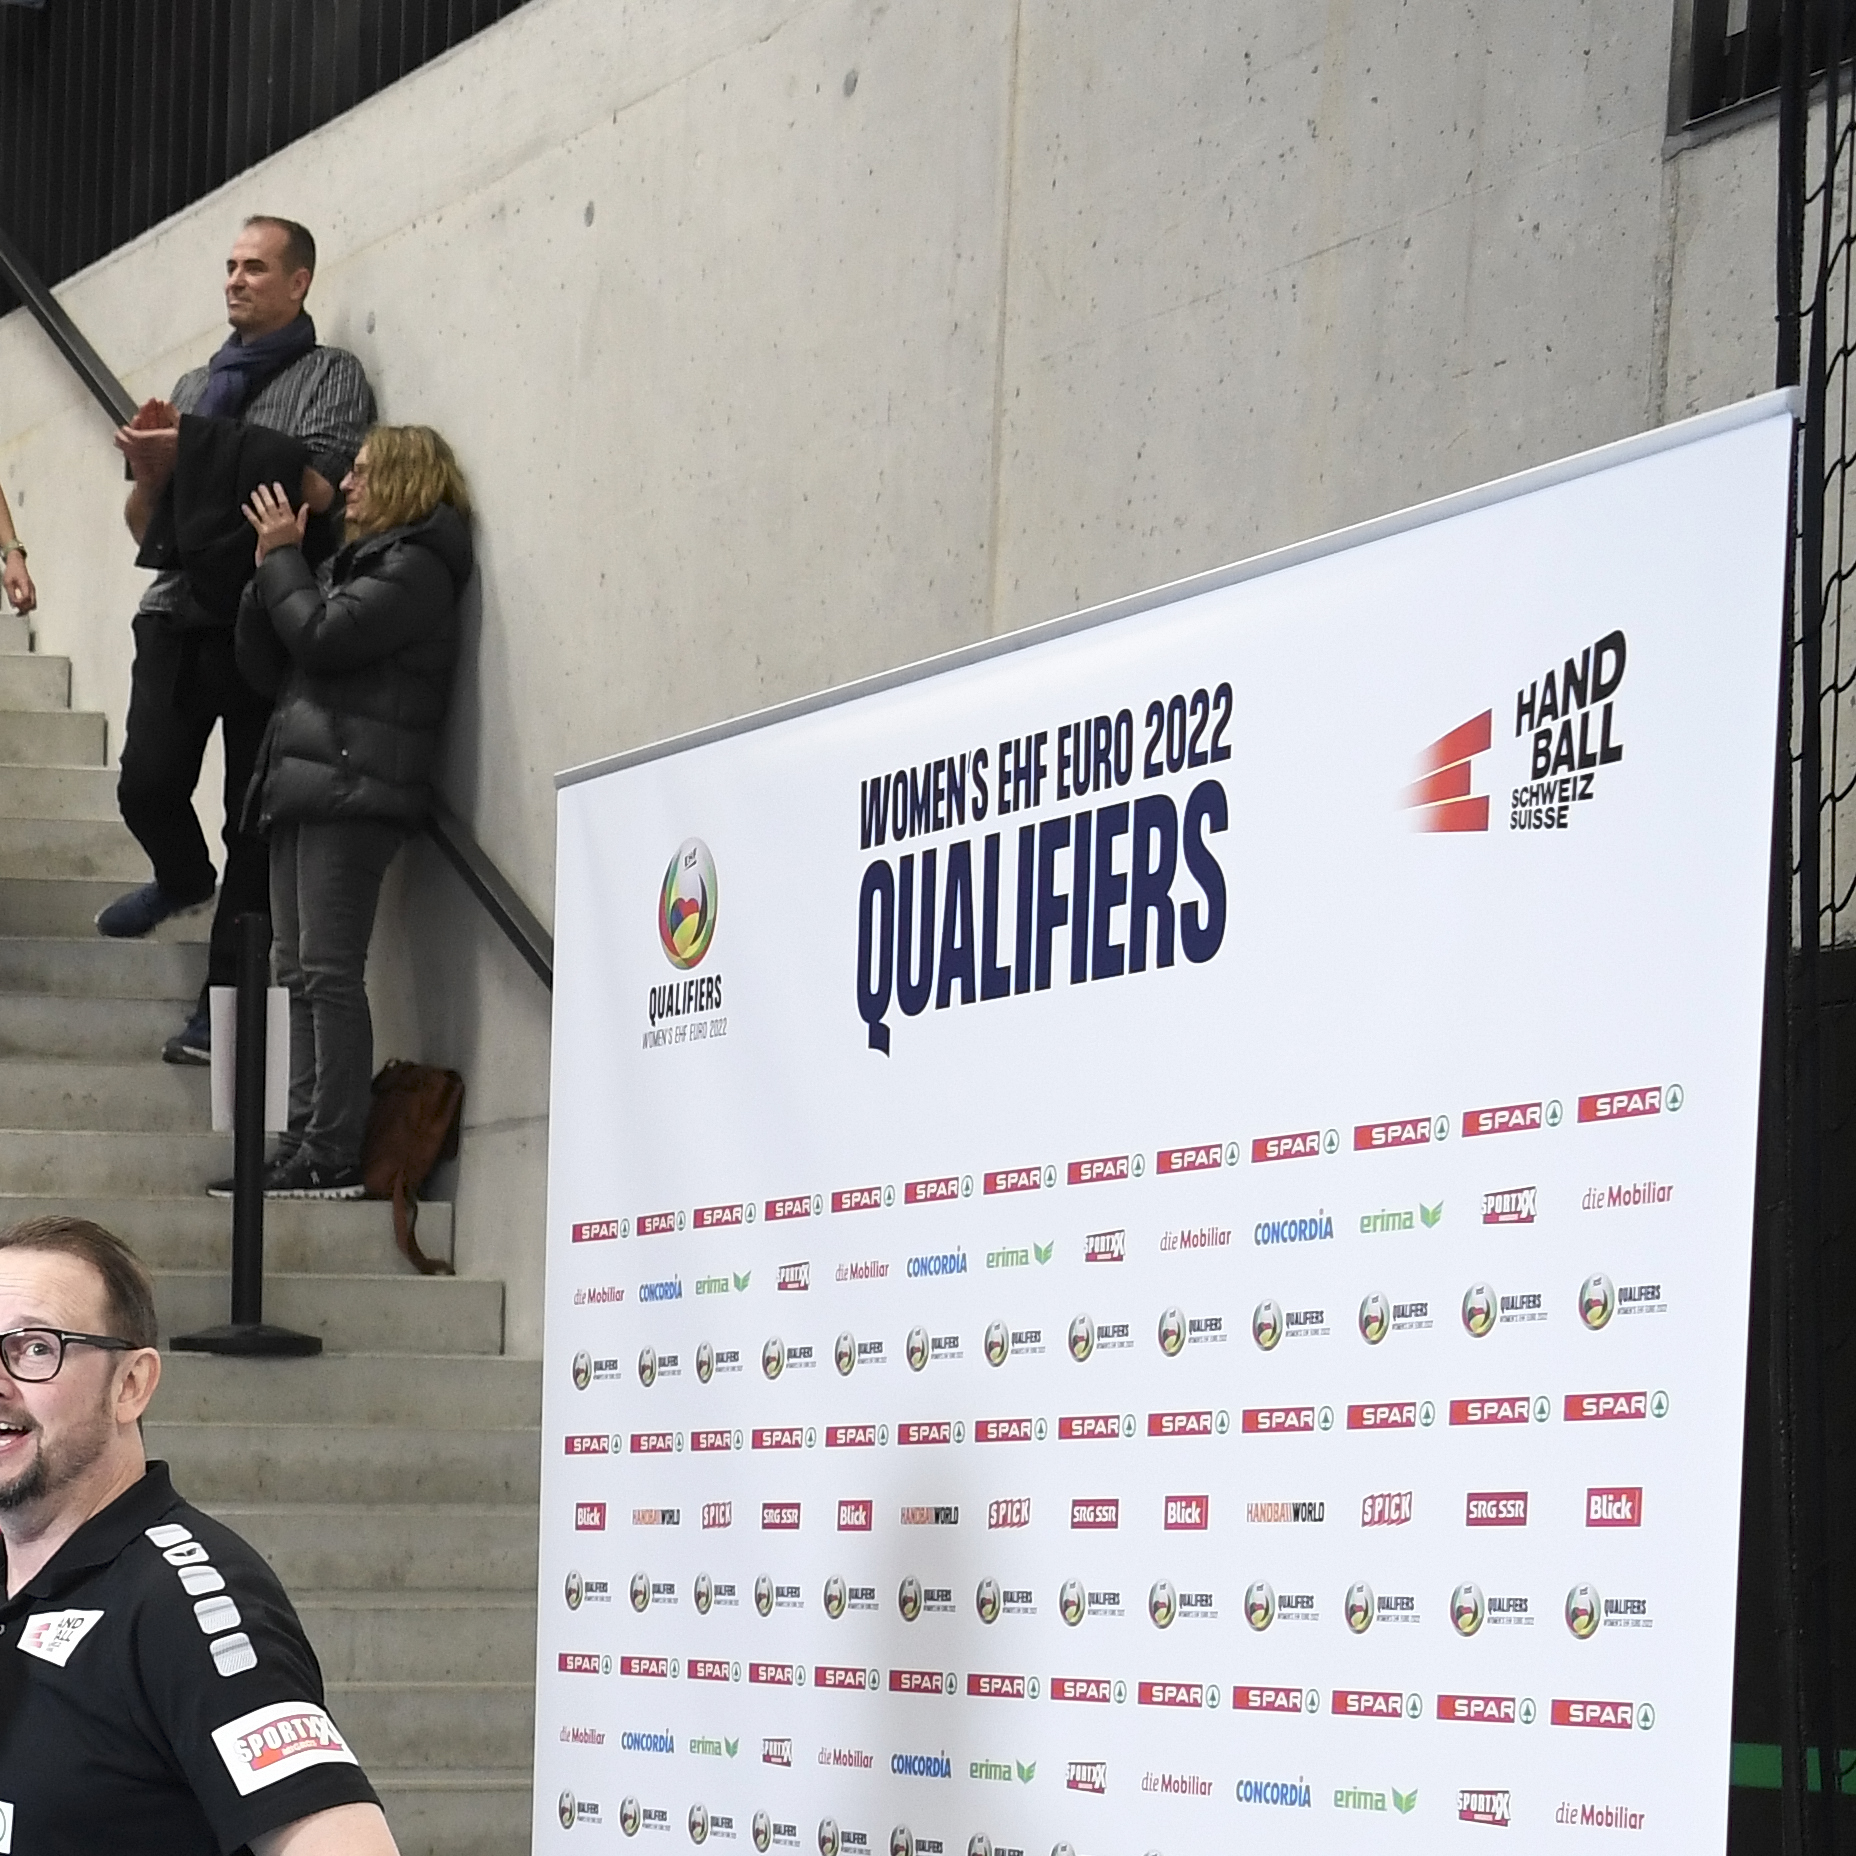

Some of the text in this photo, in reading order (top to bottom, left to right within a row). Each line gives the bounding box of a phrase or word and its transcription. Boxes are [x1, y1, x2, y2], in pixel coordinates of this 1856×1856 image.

[1515, 630, 1626, 738] HAND
[1531, 701, 1624, 781] BALL
[860, 682, 1234, 850] WOMEN'S EHF EURO 2022
[1511, 772, 1595, 809] SCHWEIZ
[1509, 805, 1570, 830] SUISSE
[856, 779, 1229, 1058] QUALIFIERS
[649, 974, 722, 1027] QUALIFIERS
[710, 1017, 727, 1039] 2022
[1596, 1090, 1660, 1116] SPAR
[1479, 1106, 1540, 1132] SPAR
[1371, 1122, 1430, 1145] SPAR
[1266, 1134, 1320, 1158] SPAR
[1080, 1159, 1128, 1180] SPAR
[1170, 1147, 1222, 1170] SPAR
[1582, 1182, 1673, 1210] die Mobiliar
[581, 1222, 618, 1239] SPAR
[1360, 1209, 1414, 1234] erima
[1160, 1228, 1232, 1251] die Mobiliar
[986, 1245, 1029, 1268] erima
[1362, 1406, 1416, 1425] SPAR
[1467, 1402, 1528, 1420] SPAR
[1582, 1396, 1646, 1416] SPAR
[1072, 1418, 1120, 1436] SPAR
[1162, 1415, 1212, 1432] SPAR
[1257, 1411, 1314, 1428] SPAR
[573, 1436, 608, 1452] SPAR
[578, 1506, 602, 1526] Blick
[1072, 1506, 1116, 1522] SRG SSR
[1166, 1501, 1201, 1524] Blick
[1363, 1493, 1412, 1522] SPICK
[1468, 1500, 1524, 1519] SRG SSR
[1590, 1492, 1632, 1520] Blick
[566, 1655, 600, 1671] SPAR
[1063, 1682, 1110, 1700] SPAR
[1151, 1686, 1202, 1704] SPAR
[1247, 1691, 1302, 1709] SPAR
[1346, 1695, 1402, 1714] SPAR
[1454, 1698, 1514, 1720] SPAR
[1568, 1704, 1632, 1726] SPAR
[1142, 1772, 1212, 1796] die Mobiliar
[1334, 1786, 1386, 1811] erima
[1555, 1802, 1644, 1829] die Mobiliar
